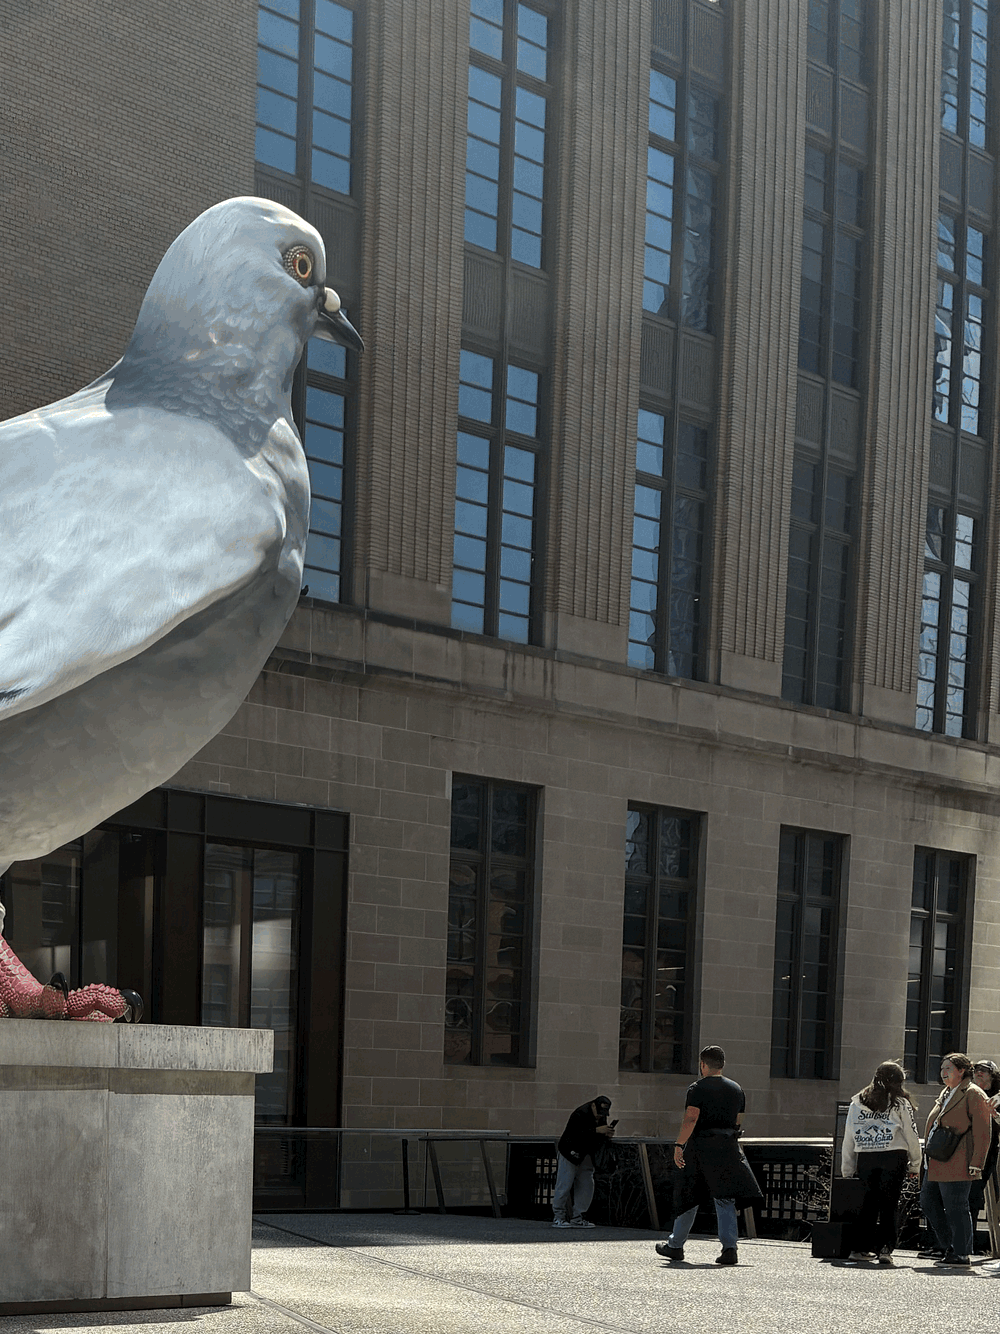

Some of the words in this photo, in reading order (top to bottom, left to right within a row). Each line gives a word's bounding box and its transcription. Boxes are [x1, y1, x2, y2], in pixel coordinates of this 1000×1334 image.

[857, 1109, 890, 1121] Sunset
[854, 1134, 874, 1142] Book
[874, 1133, 893, 1142] Club
